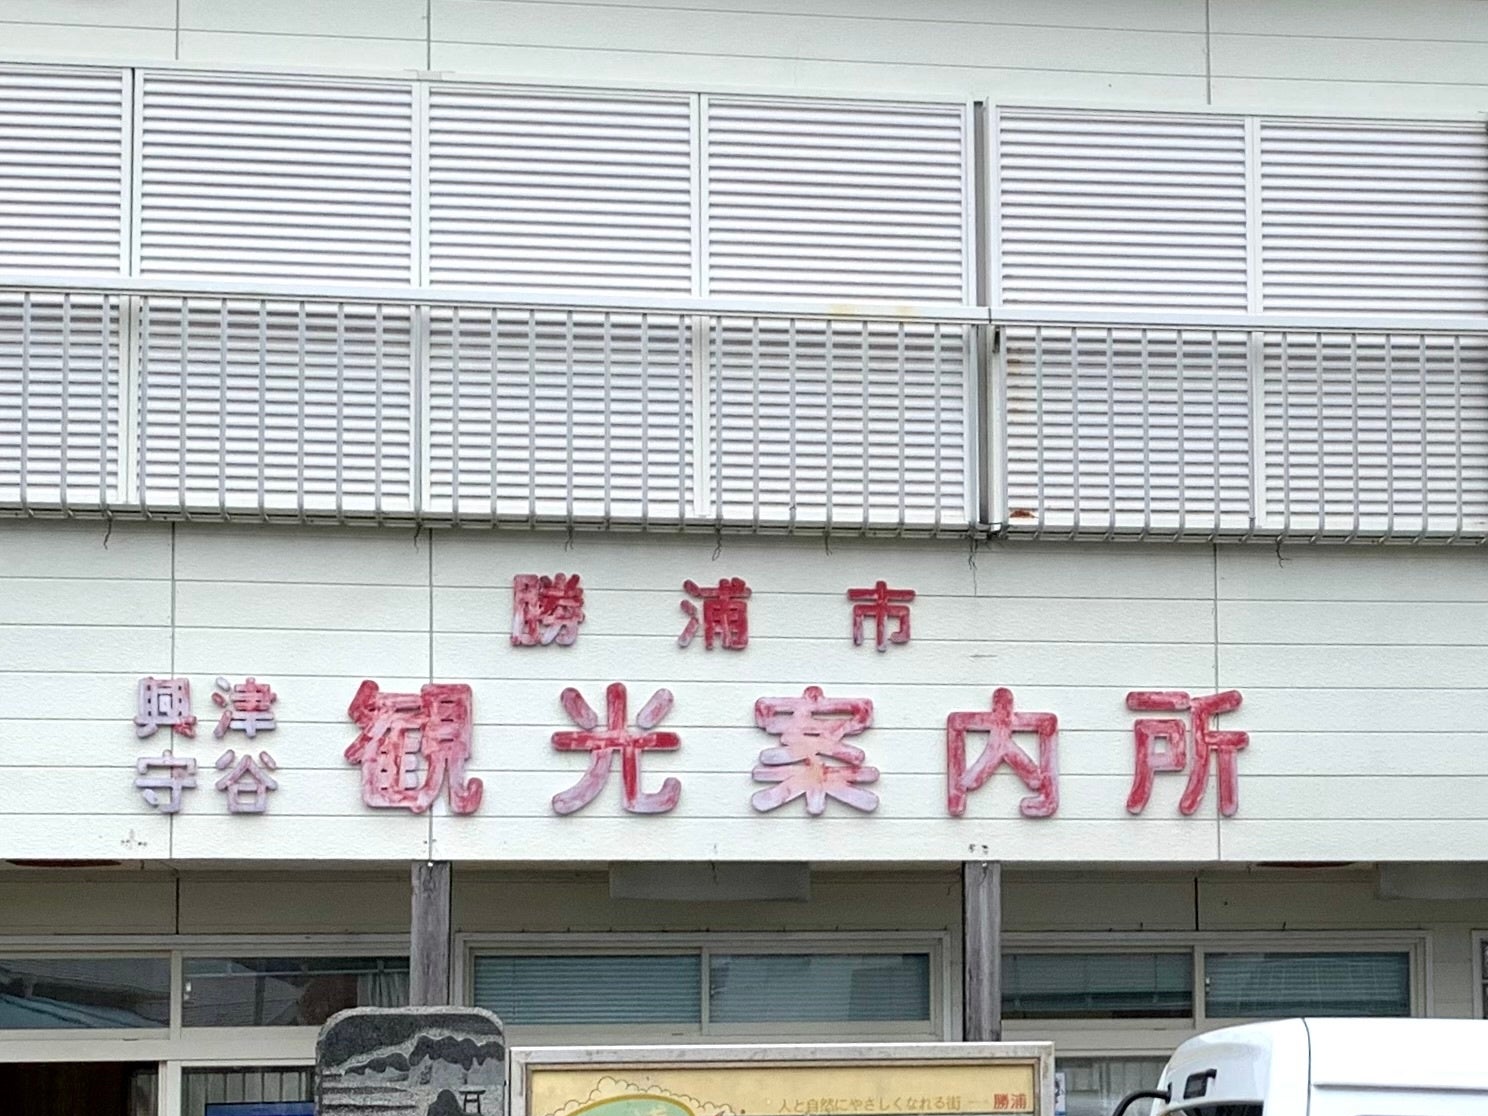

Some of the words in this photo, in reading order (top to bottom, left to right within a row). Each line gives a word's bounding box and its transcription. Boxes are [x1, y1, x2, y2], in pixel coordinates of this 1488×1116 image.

[510, 572, 917, 652] 勝浦市
[133, 676, 277, 739] 興津
[134, 748, 278, 814] 守谷
[343, 678, 1250, 820] 観光案内所
[993, 1093, 1027, 1110] 勝浦
